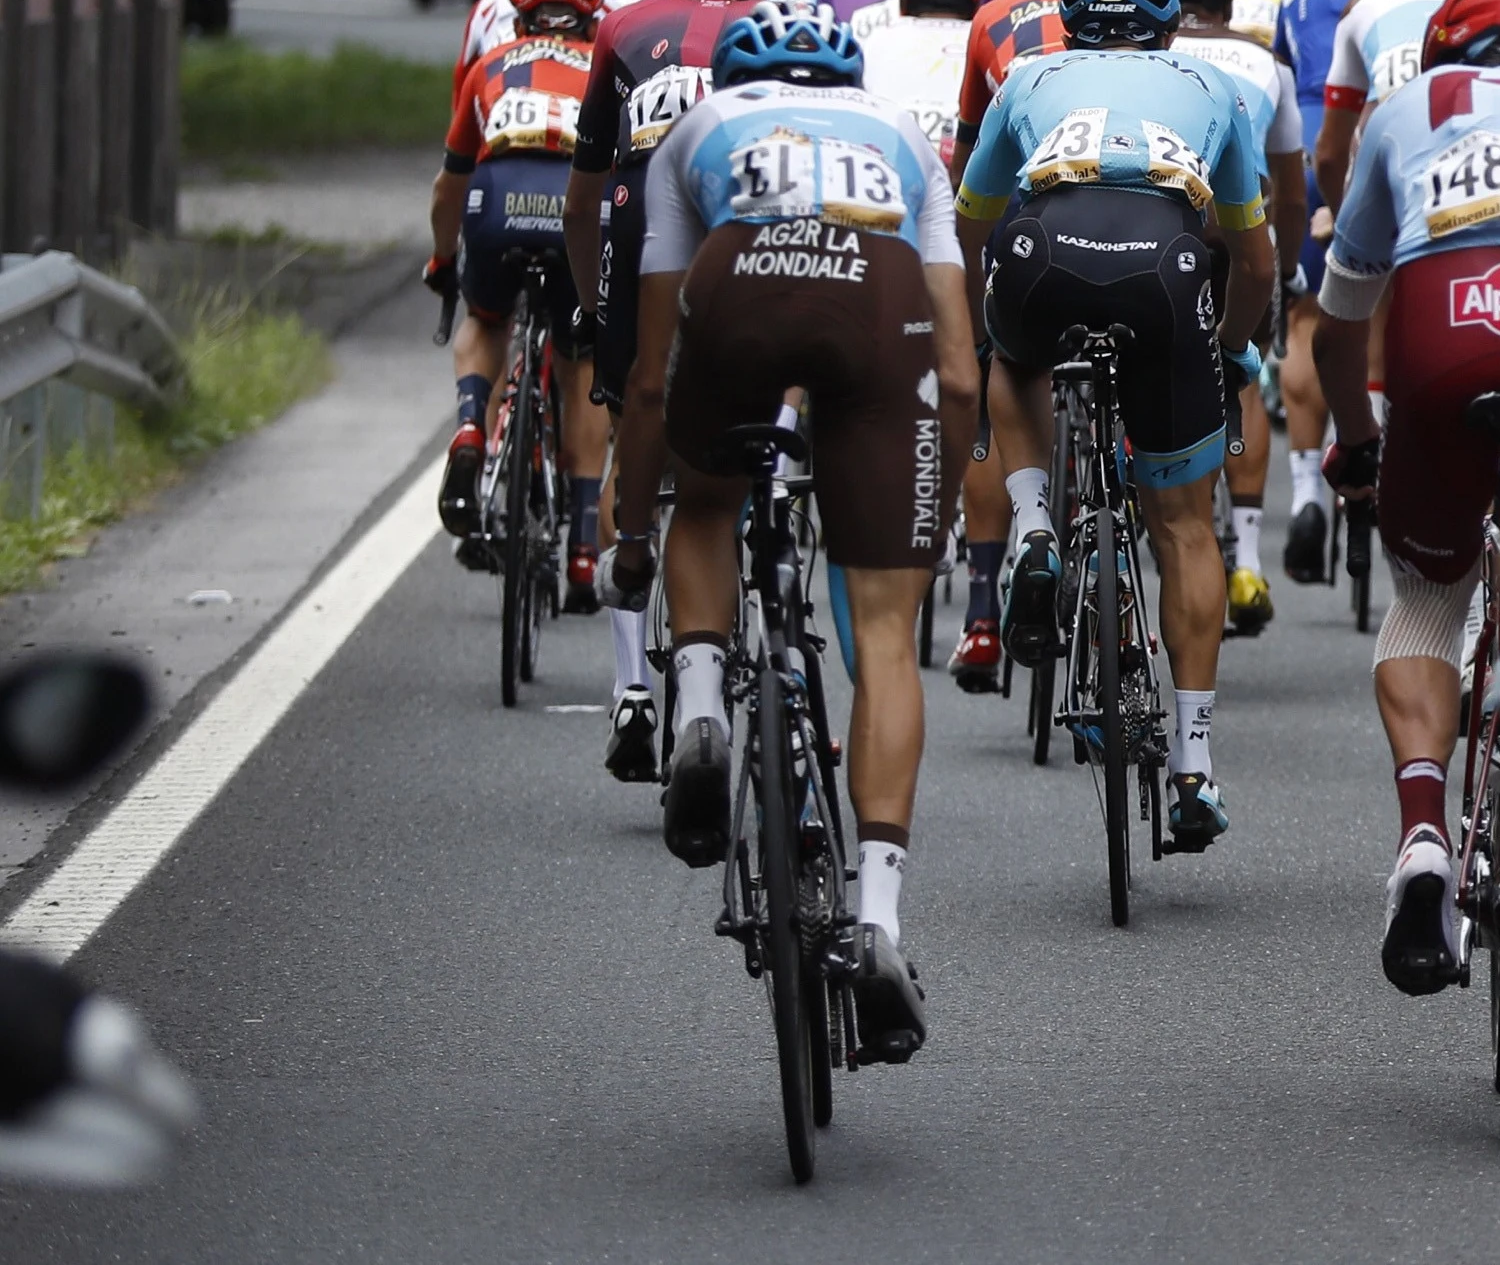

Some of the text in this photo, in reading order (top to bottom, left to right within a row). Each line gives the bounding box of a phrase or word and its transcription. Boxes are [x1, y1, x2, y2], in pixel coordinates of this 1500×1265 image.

[1037, 121, 1091, 166] 23
[836, 154, 892, 204] 13
[752, 220, 822, 249] AG2R
[825, 227, 862, 254] LA
[1056, 233, 1159, 253] KAZAKHSTAN
[733, 252, 869, 283] MONDIALE
[911, 418, 936, 550] MONDIALE
